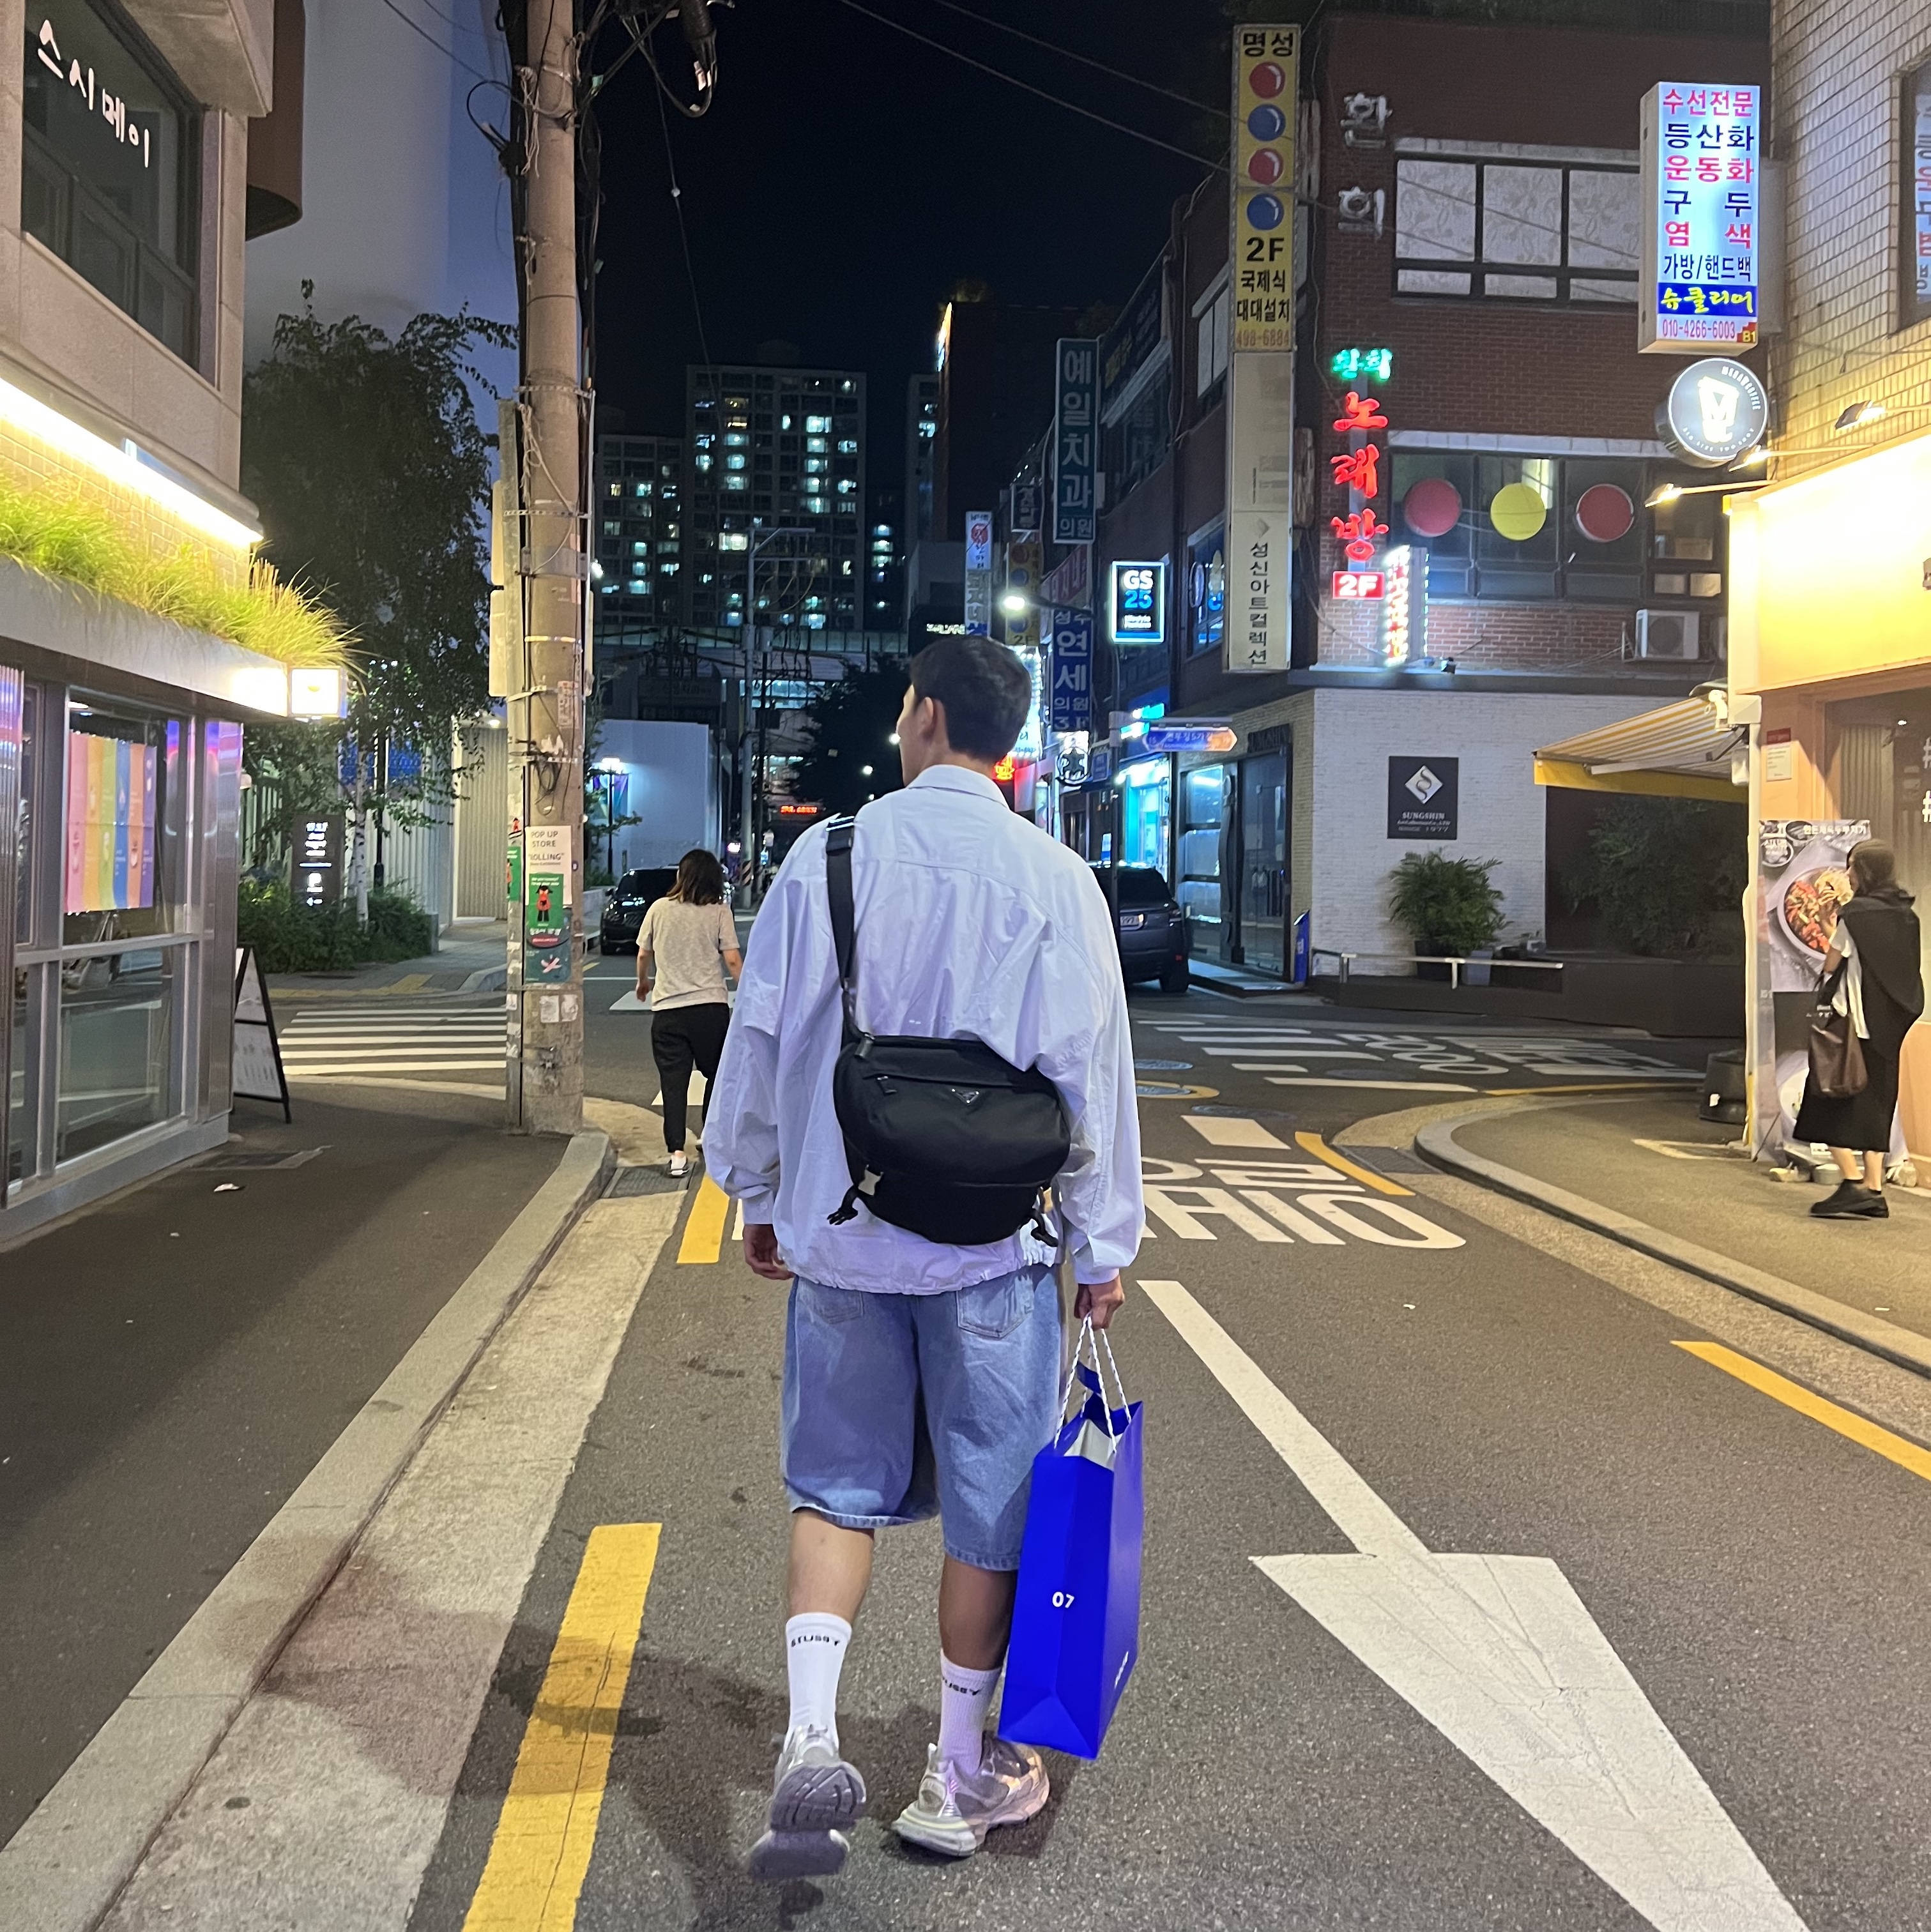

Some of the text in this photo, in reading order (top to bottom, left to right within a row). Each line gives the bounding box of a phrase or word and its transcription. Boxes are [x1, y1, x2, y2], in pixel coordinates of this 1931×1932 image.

[1242, 32, 1294, 57] 명성
[38, 19, 149, 168] 스시메이
[1663, 89, 1754, 117] 수선전문
[1664, 123, 1755, 151] 등산화
[1663, 155, 1755, 183] 운동화
[1246, 236, 1285, 262] 2F
[1663, 253, 1752, 282] 가방/핸드백
[1240, 270, 1285, 293] 국제식
[1662, 319, 1757, 343] 010-4266-6003 B1
[1060, 349, 1092, 509] 예일치과
[1331, 391, 1389, 561] 노래방
[1059, 517, 1093, 539] 의원
[1123, 570, 1154, 590] GS
[1339, 575, 1378, 597] 2F
[1124, 589, 1153, 609] 25
[1248, 542, 1271, 666] 성신아트컬렉션
[1055, 630, 1088, 691] 연세
[1054, 696, 1089, 711] 의원
[1402, 811, 1446, 820] SUNGSHIN
[1052, 1592, 1075, 1609] 07
[942, 1676, 984, 1696] USSY
